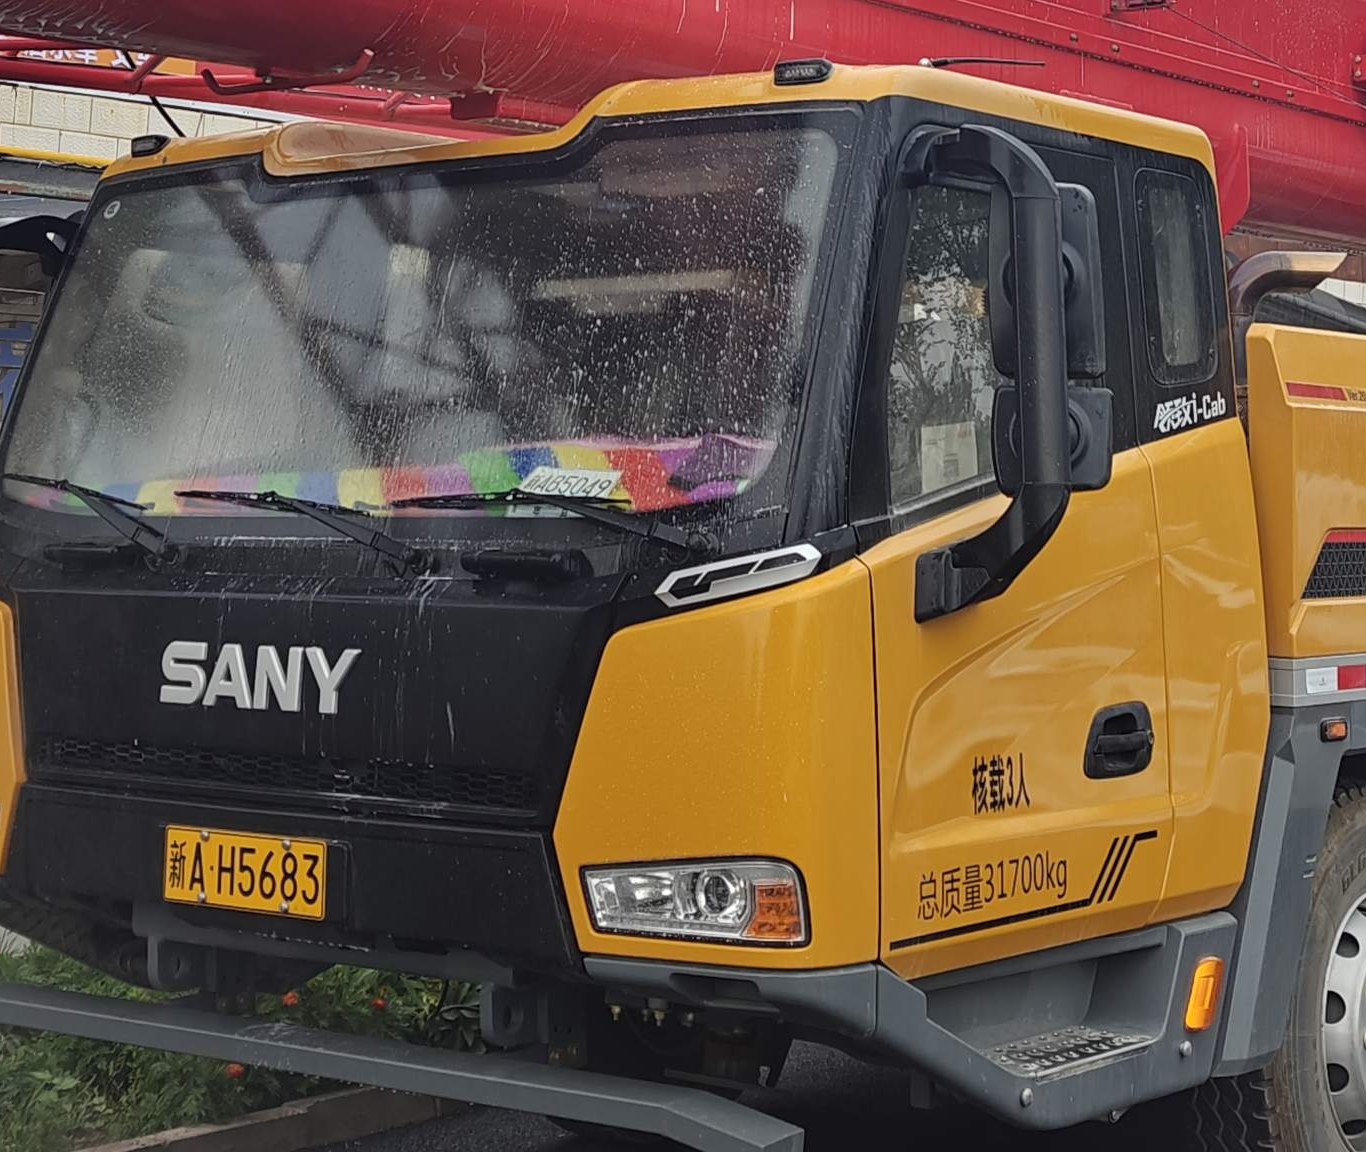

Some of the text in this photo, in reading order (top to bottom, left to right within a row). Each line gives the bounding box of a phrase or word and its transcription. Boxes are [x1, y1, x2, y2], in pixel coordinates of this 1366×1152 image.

[159, 640, 363, 715] SANY
[971, 752, 1031, 815] 核载3人
[917, 849, 1069, 921] 总质量31700kg
